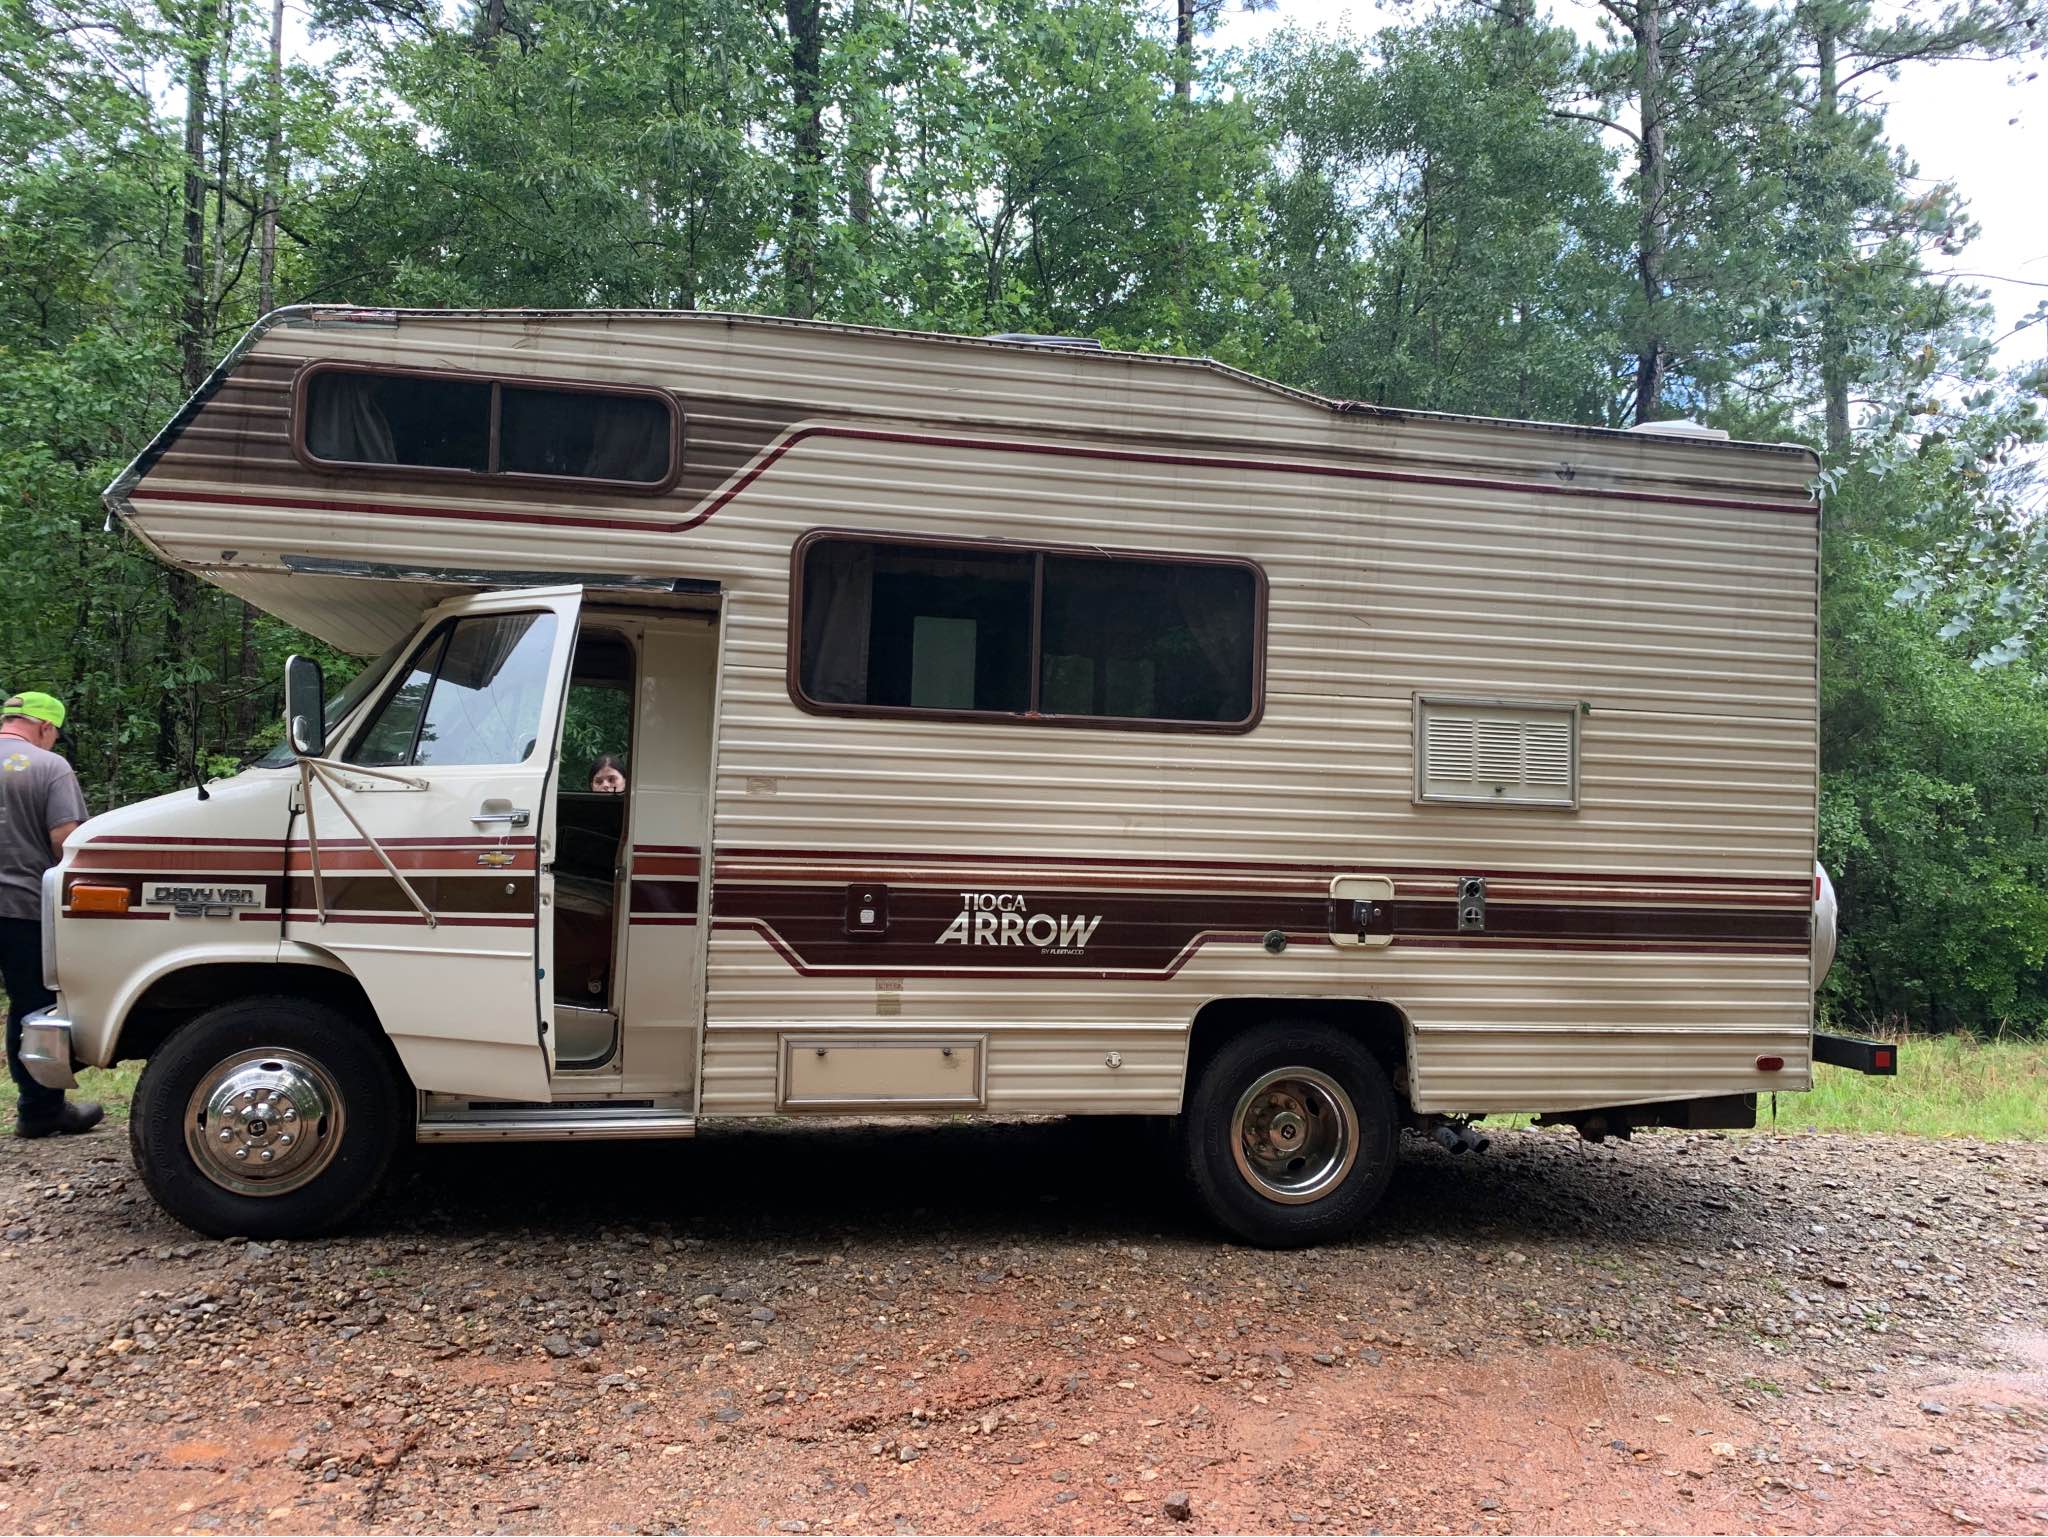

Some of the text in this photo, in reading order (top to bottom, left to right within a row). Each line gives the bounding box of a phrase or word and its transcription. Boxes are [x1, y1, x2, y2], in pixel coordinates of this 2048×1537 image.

[960, 892, 1027, 912] TIOGA
[934, 911, 1103, 948] ARROW
[1050, 948, 1085, 956] FLEETWOOD
